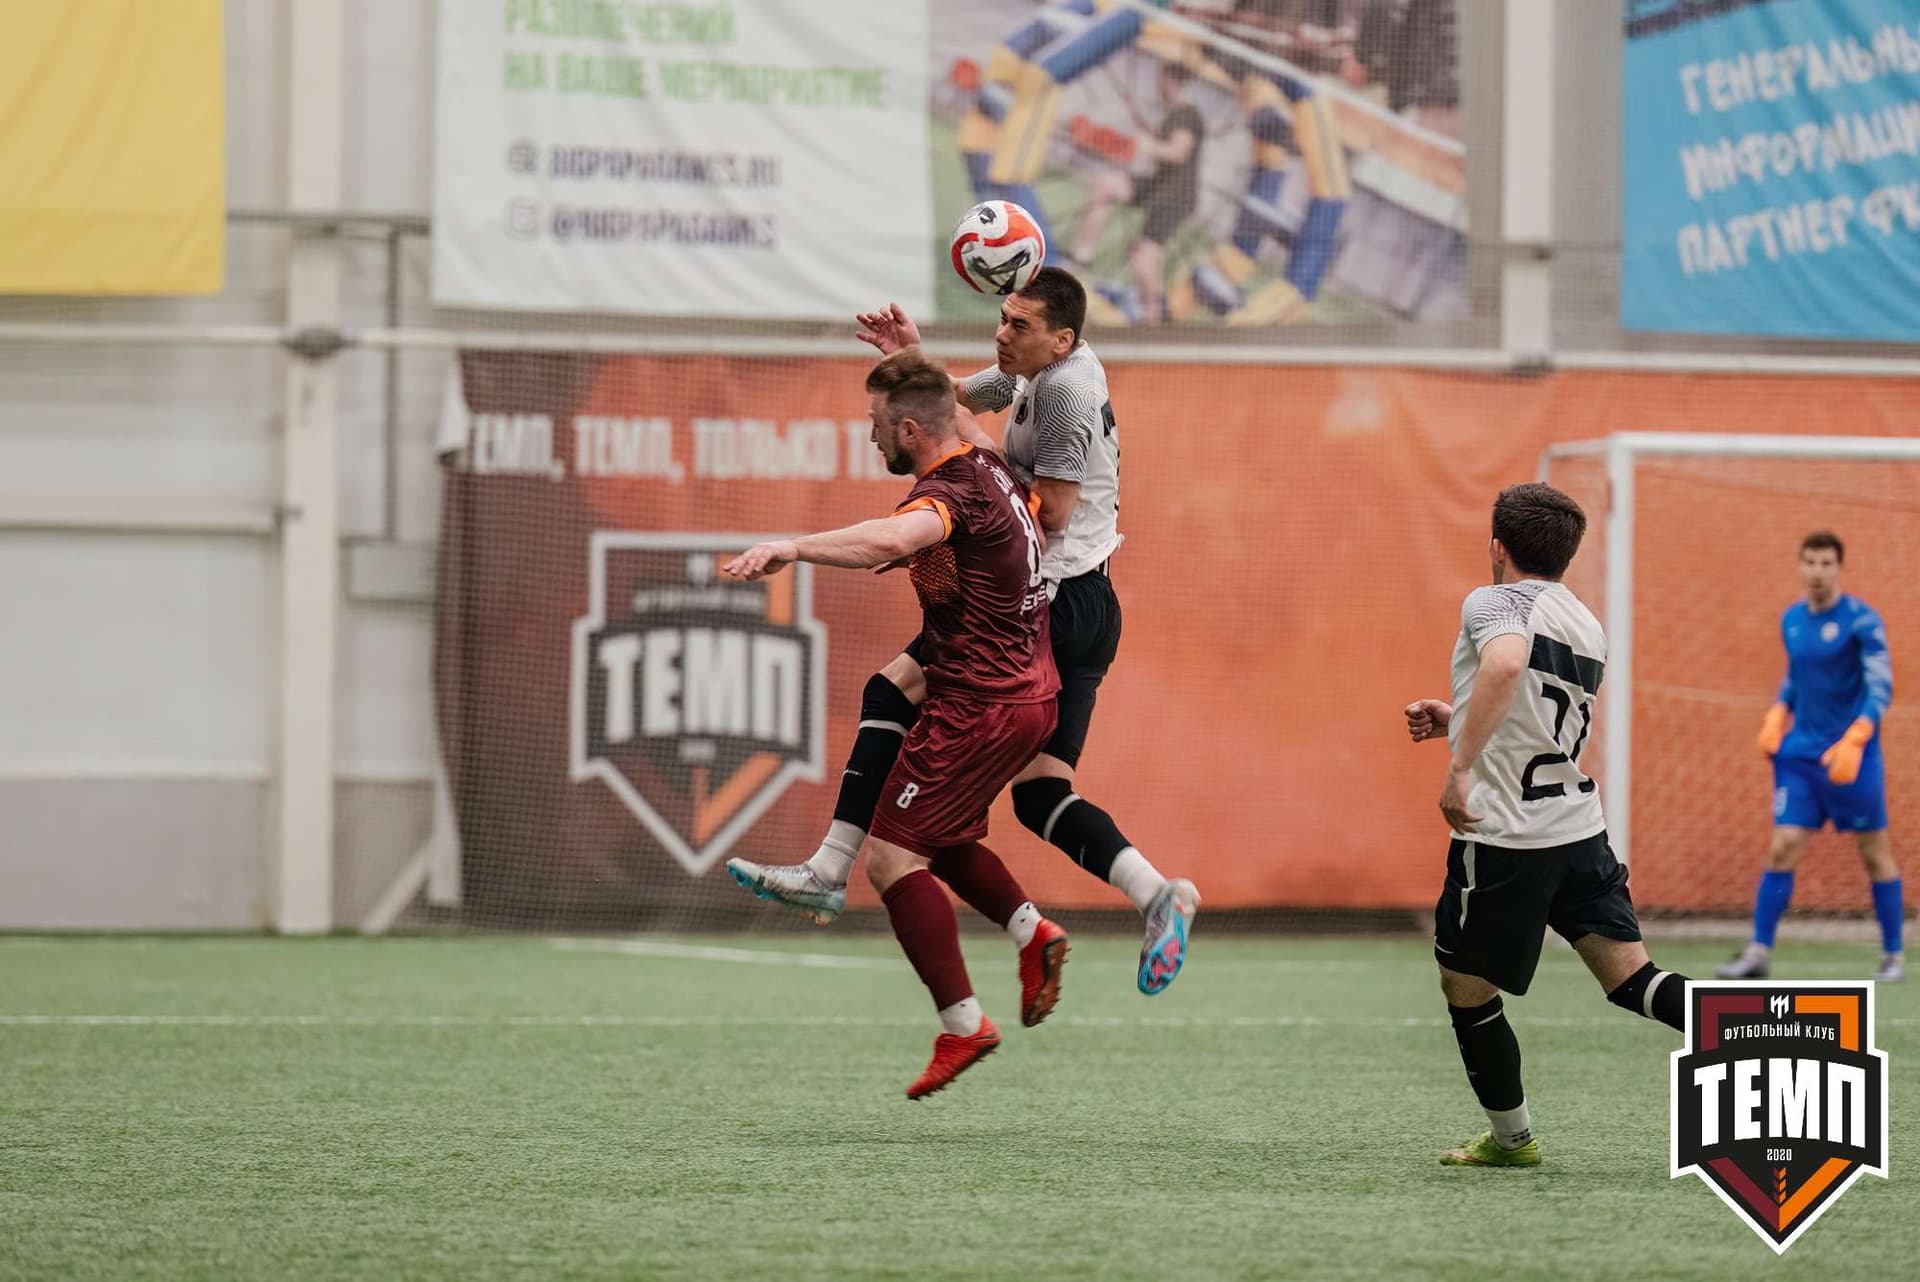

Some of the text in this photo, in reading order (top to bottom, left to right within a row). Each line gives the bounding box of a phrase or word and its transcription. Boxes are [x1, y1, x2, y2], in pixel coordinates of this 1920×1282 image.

[1677, 194, 1855, 275] ПАРТНЕР
[575, 417, 684, 483] ТЕМП,
[693, 419, 838, 481] ТОЛЬКО
[1010, 493, 1042, 588] 8
[599, 627, 802, 747] ТЕМП
[896, 782, 920, 809] 8
